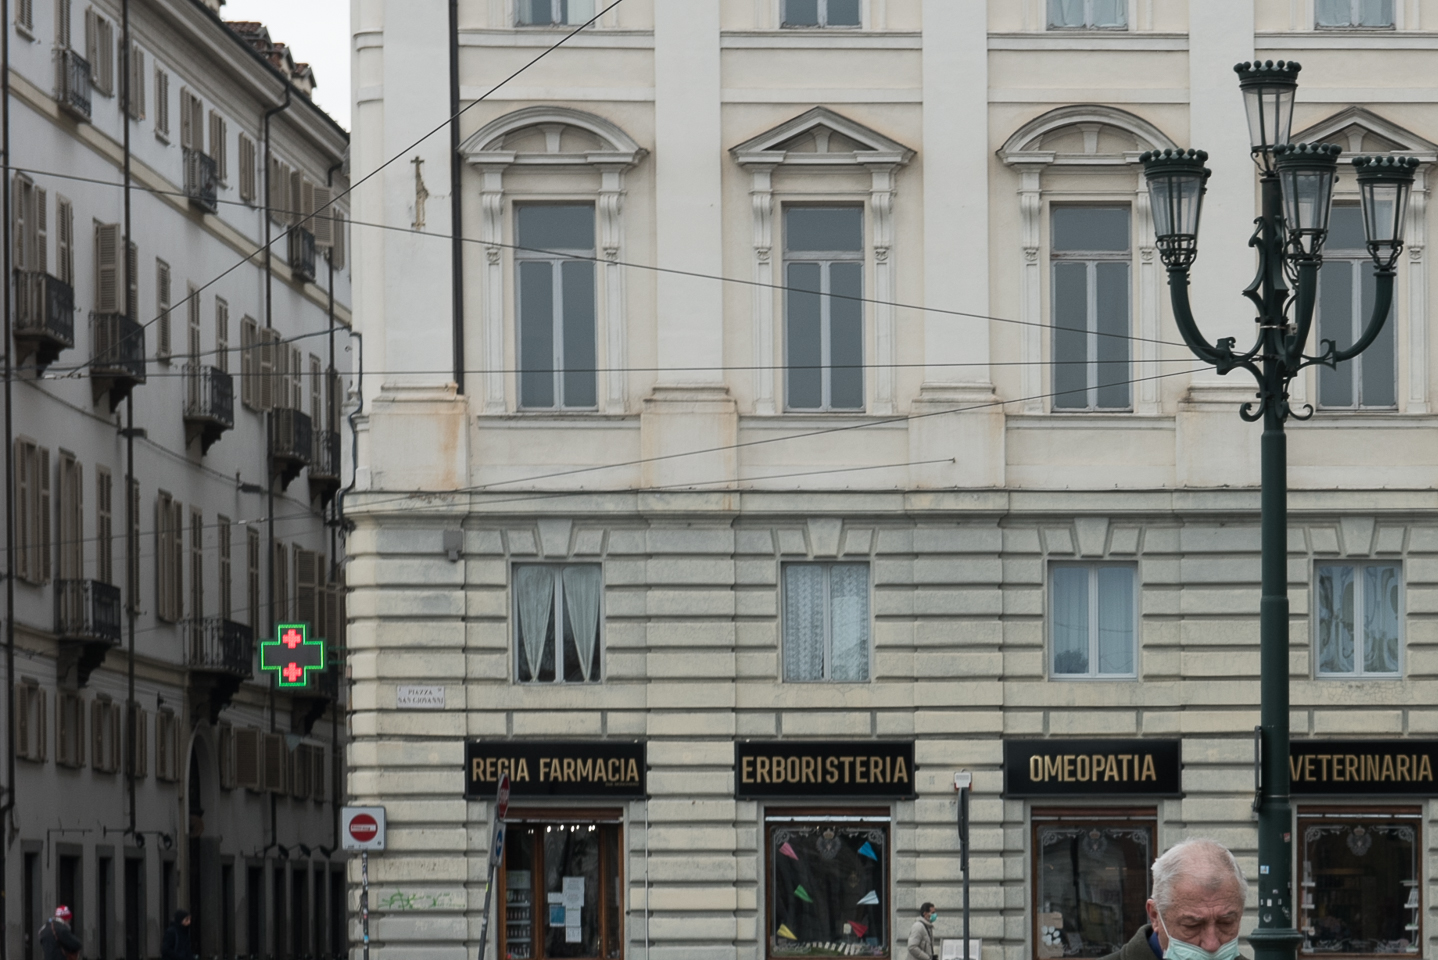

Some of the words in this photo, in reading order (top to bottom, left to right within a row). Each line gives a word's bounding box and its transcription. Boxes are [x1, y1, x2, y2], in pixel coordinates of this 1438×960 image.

[472, 757, 530, 782] REGIA
[539, 757, 639, 782] FARMACIA
[742, 756, 908, 783] ERBORISTERIA
[1029, 754, 1157, 782] OMEOPATIA
[1289, 754, 1434, 782] VETERINARIA
